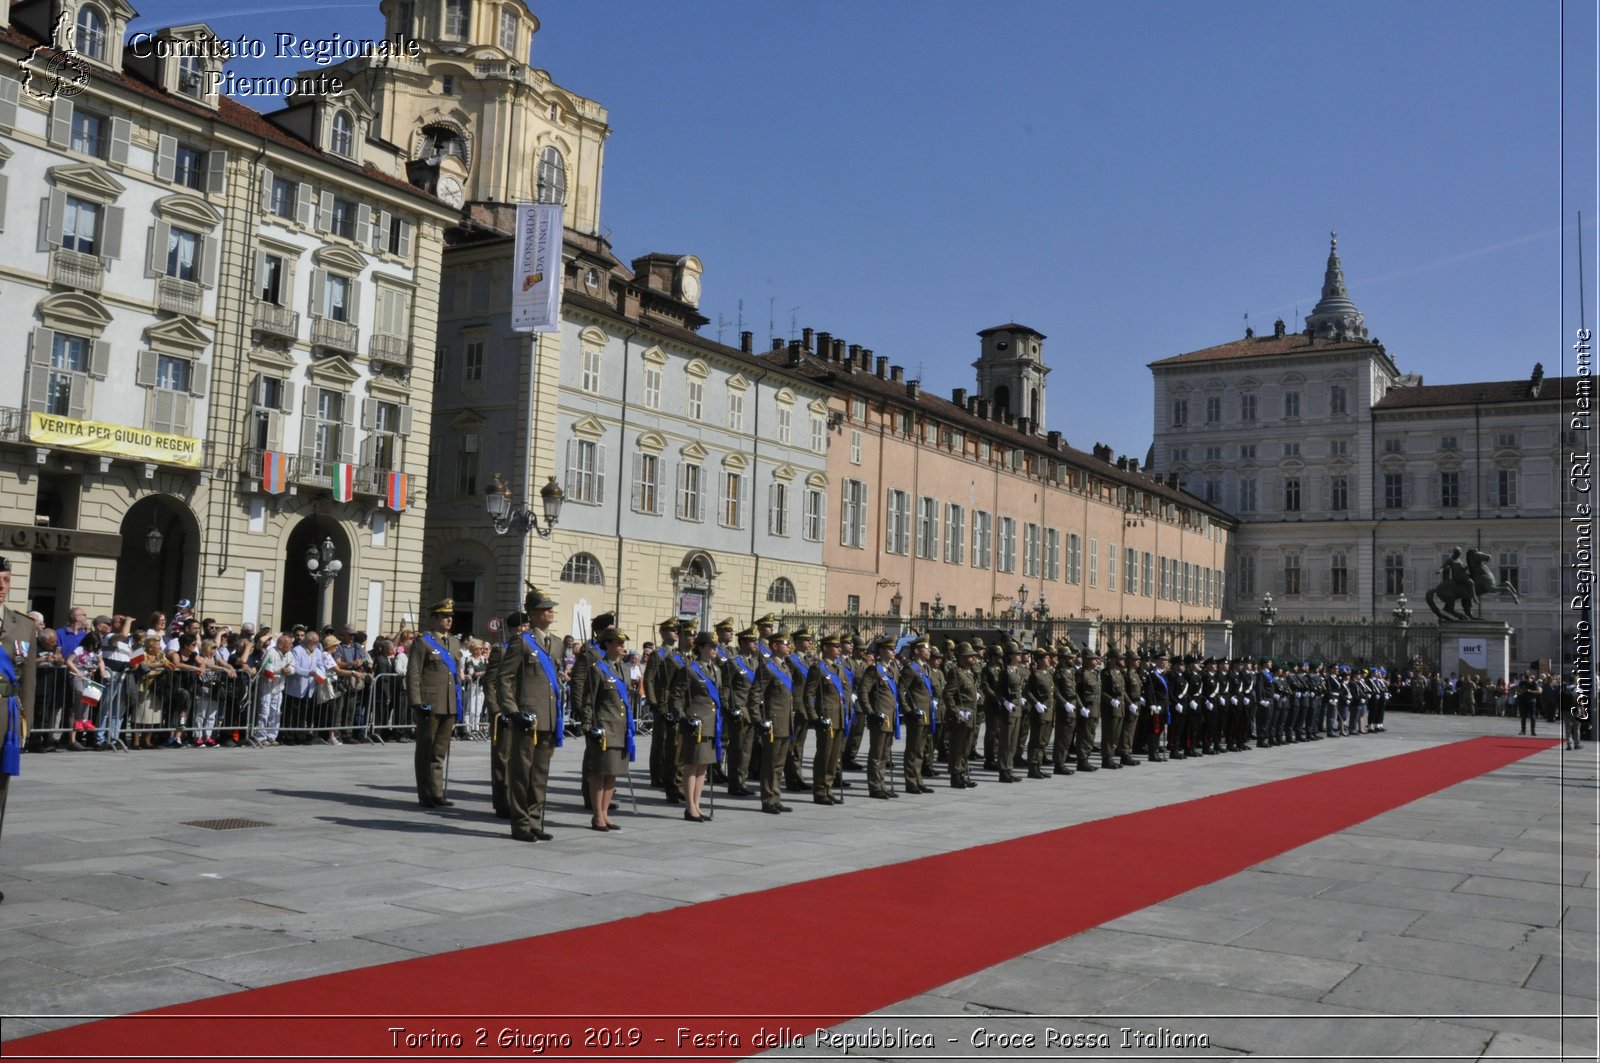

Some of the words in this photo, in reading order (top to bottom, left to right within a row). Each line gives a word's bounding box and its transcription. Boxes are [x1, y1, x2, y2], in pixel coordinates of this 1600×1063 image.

[523, 209, 536, 273] LEONARDO
[537, 220, 549, 253] VINCI
[536, 255, 545, 273] DA
[40, 417, 84, 437] VERITÀ
[88, 425, 111, 440] PER
[114, 429, 152, 447] GIULIO
[155, 436, 195, 453] REGENI
